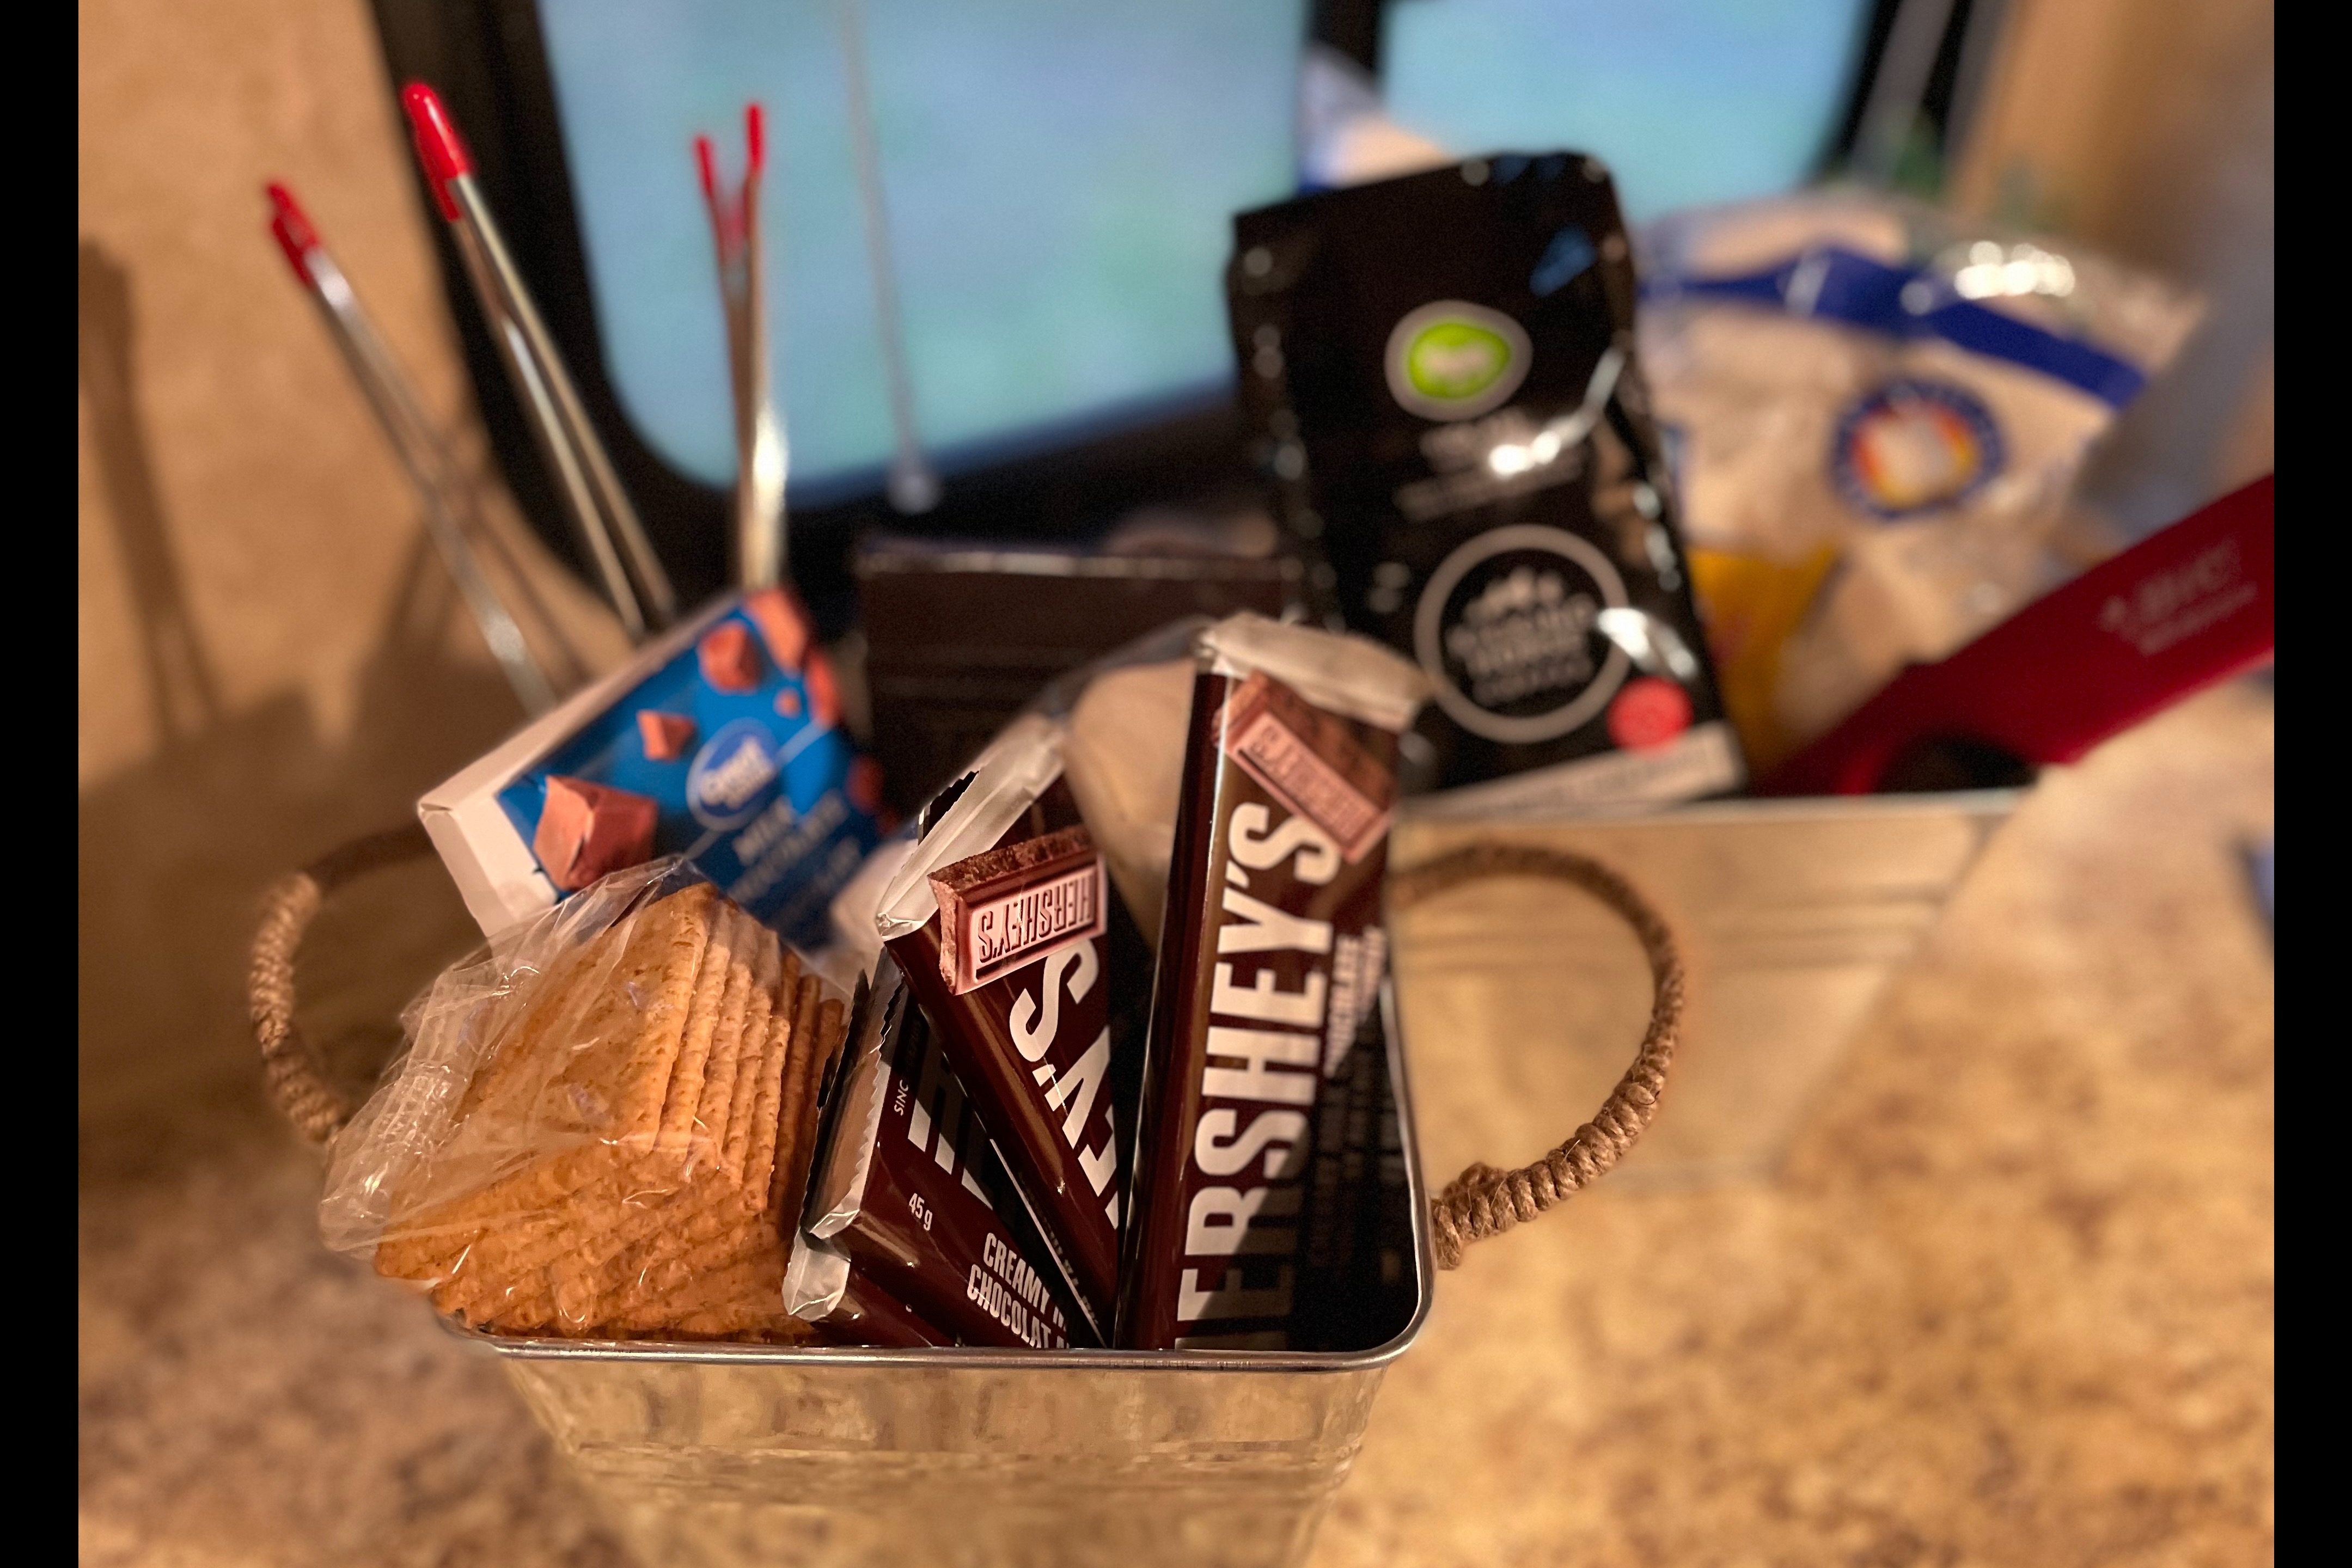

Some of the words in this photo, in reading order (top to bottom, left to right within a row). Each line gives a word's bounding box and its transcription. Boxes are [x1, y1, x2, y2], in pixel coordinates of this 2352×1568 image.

[978, 875, 1095, 963] HERSHEY'S
[893, 1074, 911, 1116] SINC
[908, 1192, 923, 1219] 45
[922, 1211, 933, 1231] g
[967, 1263, 1052, 1349] CHOCOLAT
[983, 1232, 1050, 1315] CREAMY
